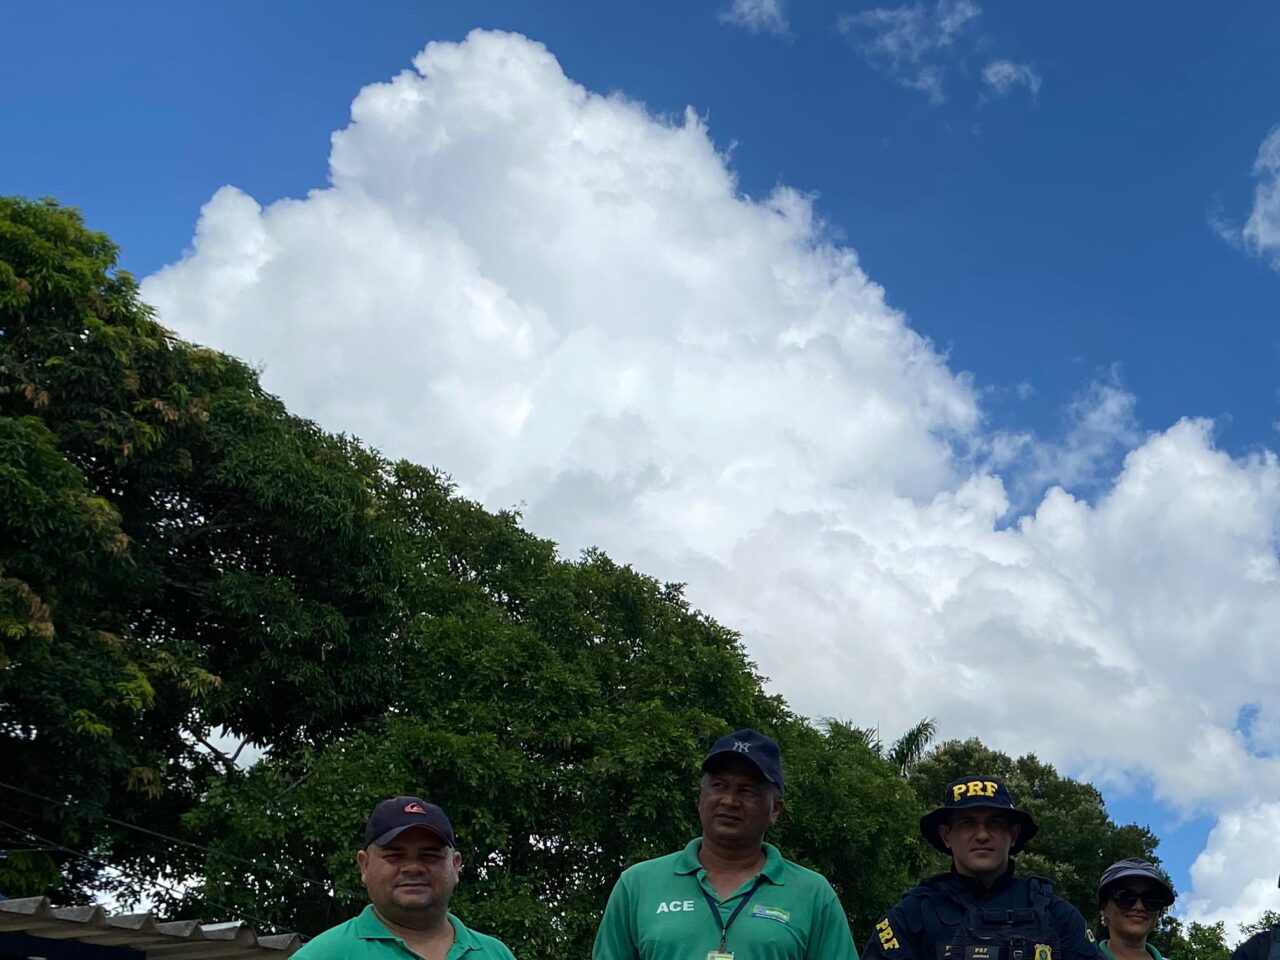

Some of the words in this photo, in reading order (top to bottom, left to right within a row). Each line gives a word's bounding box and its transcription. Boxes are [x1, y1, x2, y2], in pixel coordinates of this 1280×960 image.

[952, 781, 999, 801] PRF
[656, 900, 695, 914] ACE
[875, 918, 900, 951] PRF
